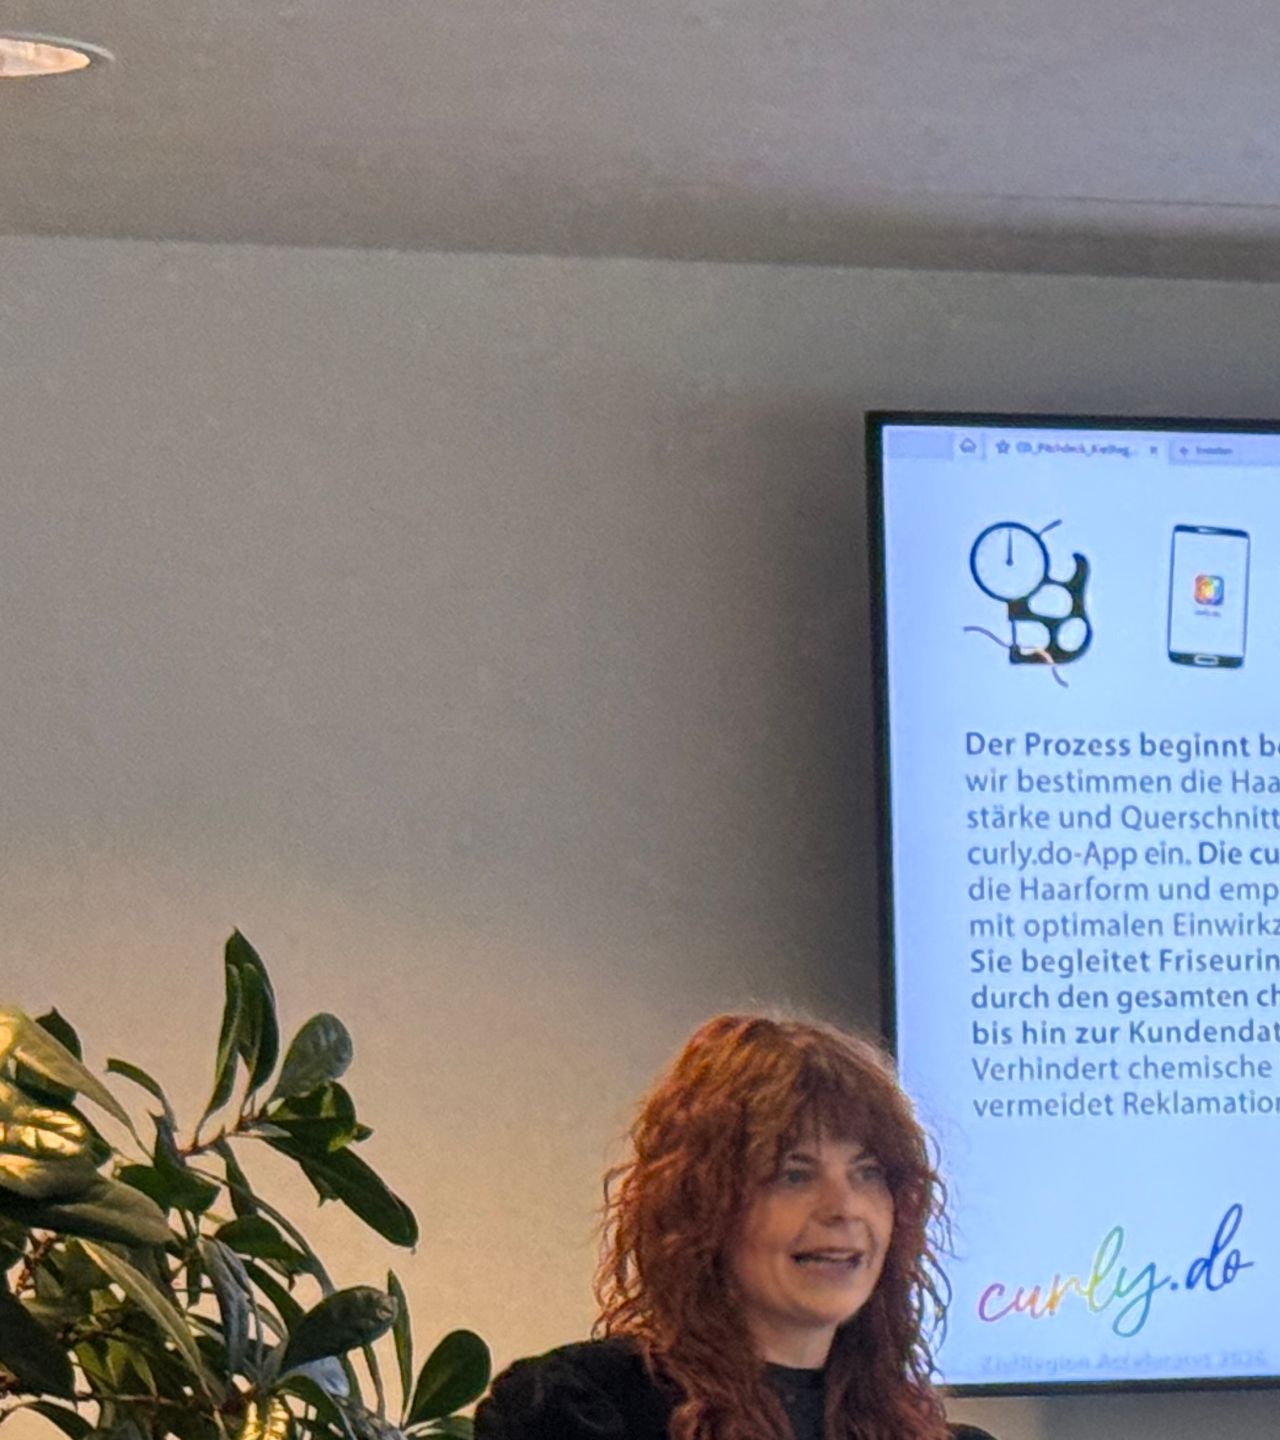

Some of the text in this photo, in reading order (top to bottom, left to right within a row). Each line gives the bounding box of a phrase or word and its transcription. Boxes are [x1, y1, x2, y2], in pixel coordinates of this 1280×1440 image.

[965, 731, 1017, 757] Der
[1024, 731, 1131, 758] Prozess
[1139, 731, 1251, 764] beginnt
[965, 769, 1009, 793] wir
[1016, 767, 1172, 794] bestimmen
[1180, 768, 1223, 794] die
[966, 803, 1051, 830] stärke
[1058, 803, 1112, 830] und
[1120, 804, 1280, 832] Querschnitt
[967, 839, 1138, 872] curly.do-App
[1144, 840, 1192, 866] ein.
[1198, 839, 1243, 866] Die
[968, 875, 1012, 902] die
[1020, 875, 1149, 902] Haarform
[1158, 875, 1211, 901] und
[969, 912, 1016, 938] mit
[1023, 911, 1164, 944] optimalen
[970, 948, 1013, 974] Sie
[1021, 947, 1151, 980] begleitet
[970, 983, 1050, 1010] durch
[1057, 983, 1109, 1009] den
[1116, 986, 1249, 1015] gesamten
[972, 1020, 1013, 1046] bis
[1021, 1019, 1066, 1045] hin
[1075, 1026, 1121, 1045] zur
[971, 1055, 1120, 1082] Verhindert
[1127, 1053, 1273, 1080] chemische
[972, 1091, 1114, 1118] vermeidet
[977, 1203, 1255, 1338] curly.do
